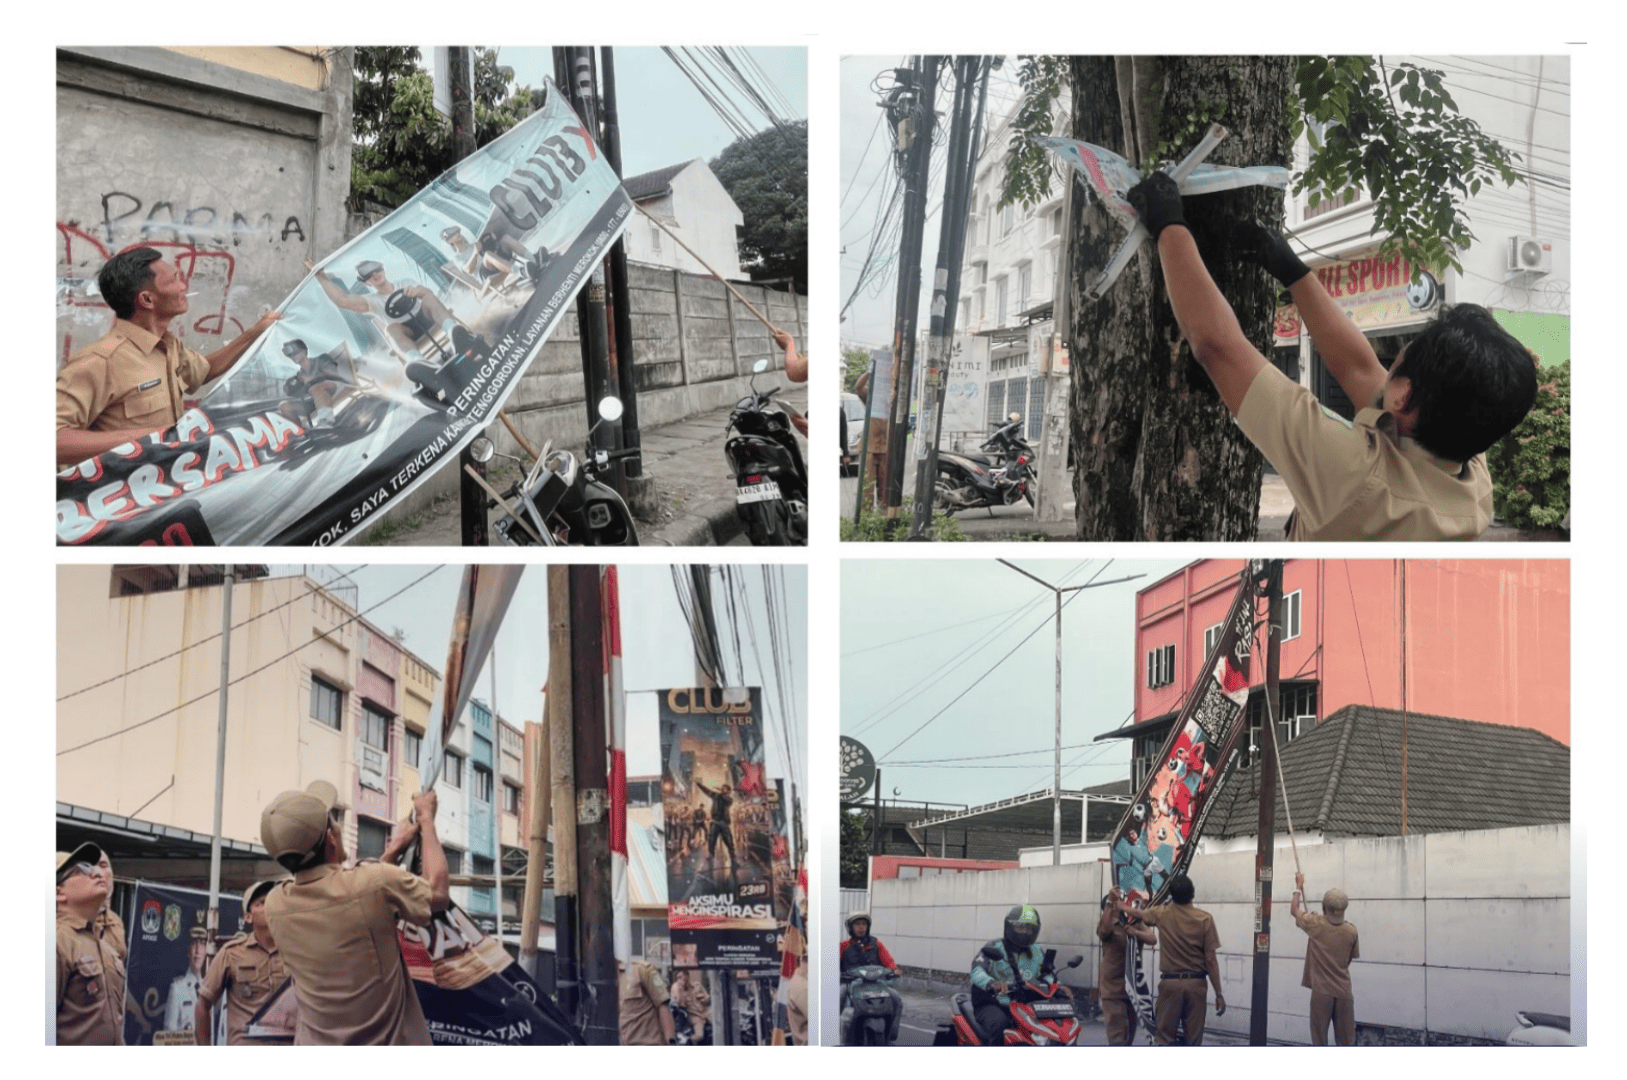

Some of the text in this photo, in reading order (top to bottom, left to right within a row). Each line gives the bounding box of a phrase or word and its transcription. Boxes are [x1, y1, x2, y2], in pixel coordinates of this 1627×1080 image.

[489, 134, 586, 230] CLUB
[350, 487, 390, 523] SAYA
[389, 435, 448, 490] TERKENA
[465, 344, 529, 424] TENGGOROKAN,
[522, 305, 554, 346] LAYANAN
[547, 271, 580, 309] BERHENTI
[446, 334, 515, 418] PERINGATAN
[56, 411, 304, 543] BERSAMA
[716, 716, 753, 726] FILTER
[671, 904, 773, 920] MENGINSPIRASI
[689, 893, 734, 907] AKSIMU
